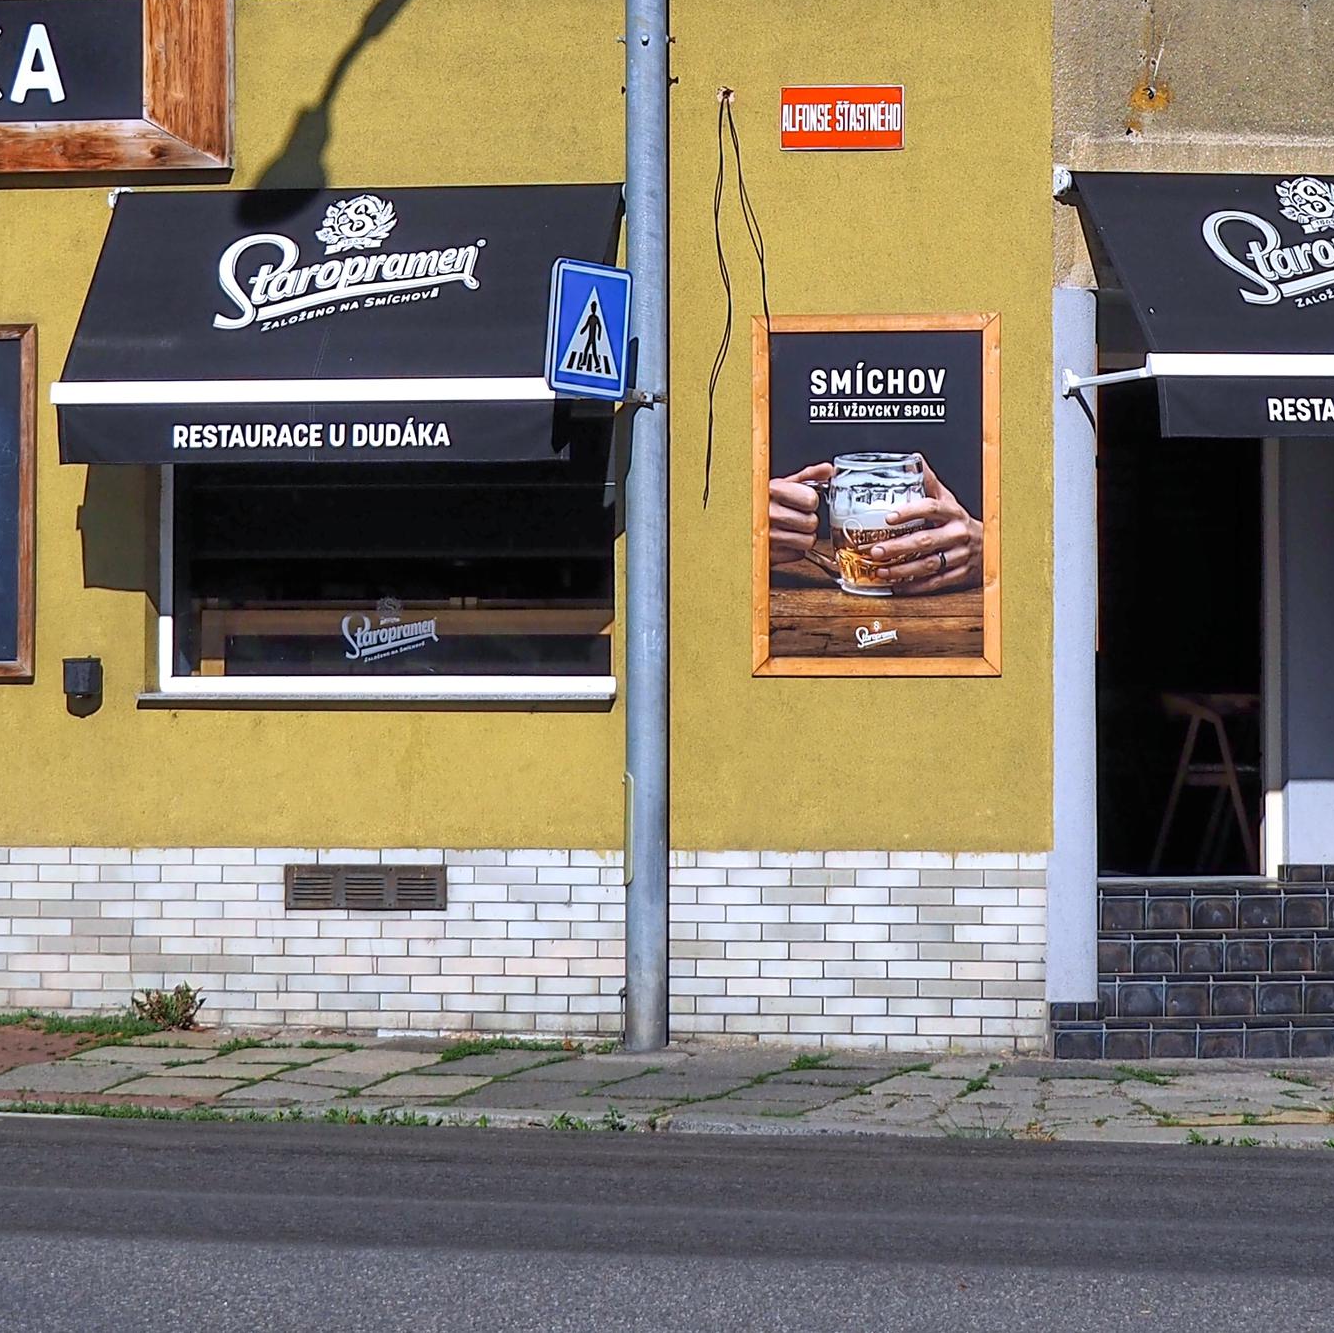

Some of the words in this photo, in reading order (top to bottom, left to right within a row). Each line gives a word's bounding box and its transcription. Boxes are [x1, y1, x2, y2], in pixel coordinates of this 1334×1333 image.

[782, 104, 832, 131] ALFONSE
[213, 233, 481, 331] Staropramen
[810, 362, 946, 395] SMÍCHOV
[810, 402, 839, 417] DRŽÍ
[843, 402, 900, 417] VŽDYCKY
[904, 404, 945, 417] SPOLU
[173, 422, 323, 449] RESTAURACE
[329, 423, 347, 447] U
[352, 417, 451, 448] DUDÁKA
[342, 612, 439, 659] Staropramen
